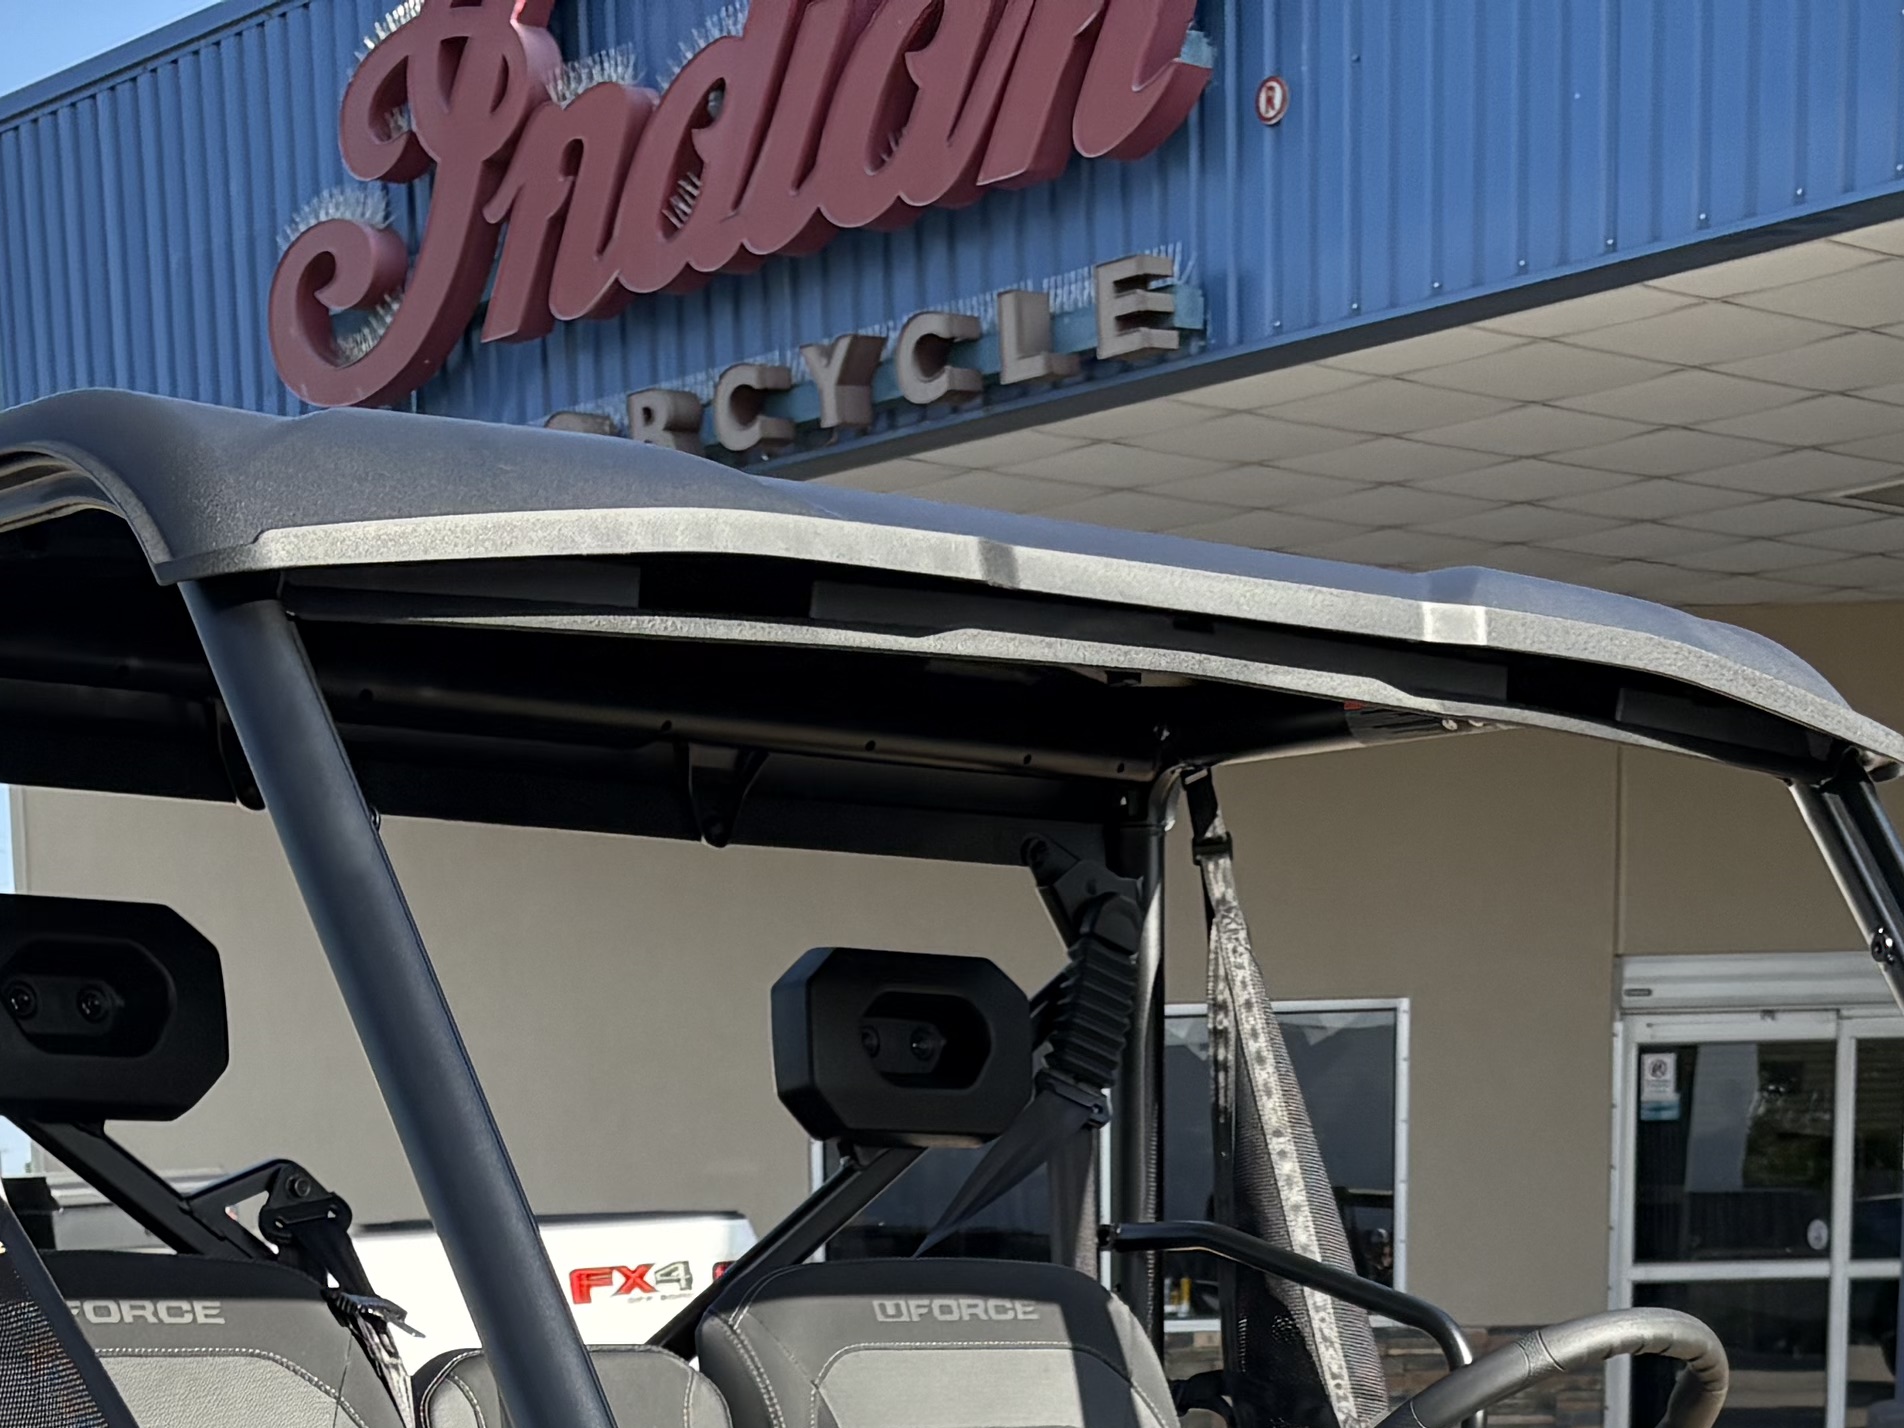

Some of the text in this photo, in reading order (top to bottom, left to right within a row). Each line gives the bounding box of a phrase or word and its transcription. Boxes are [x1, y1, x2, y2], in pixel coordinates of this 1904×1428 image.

[268, 0, 1212, 407] Indian
[545, 254, 1180, 453] RCYCLE
[569, 1261, 693, 1304] FX4
[872, 1298, 1040, 1322] UFORCE
